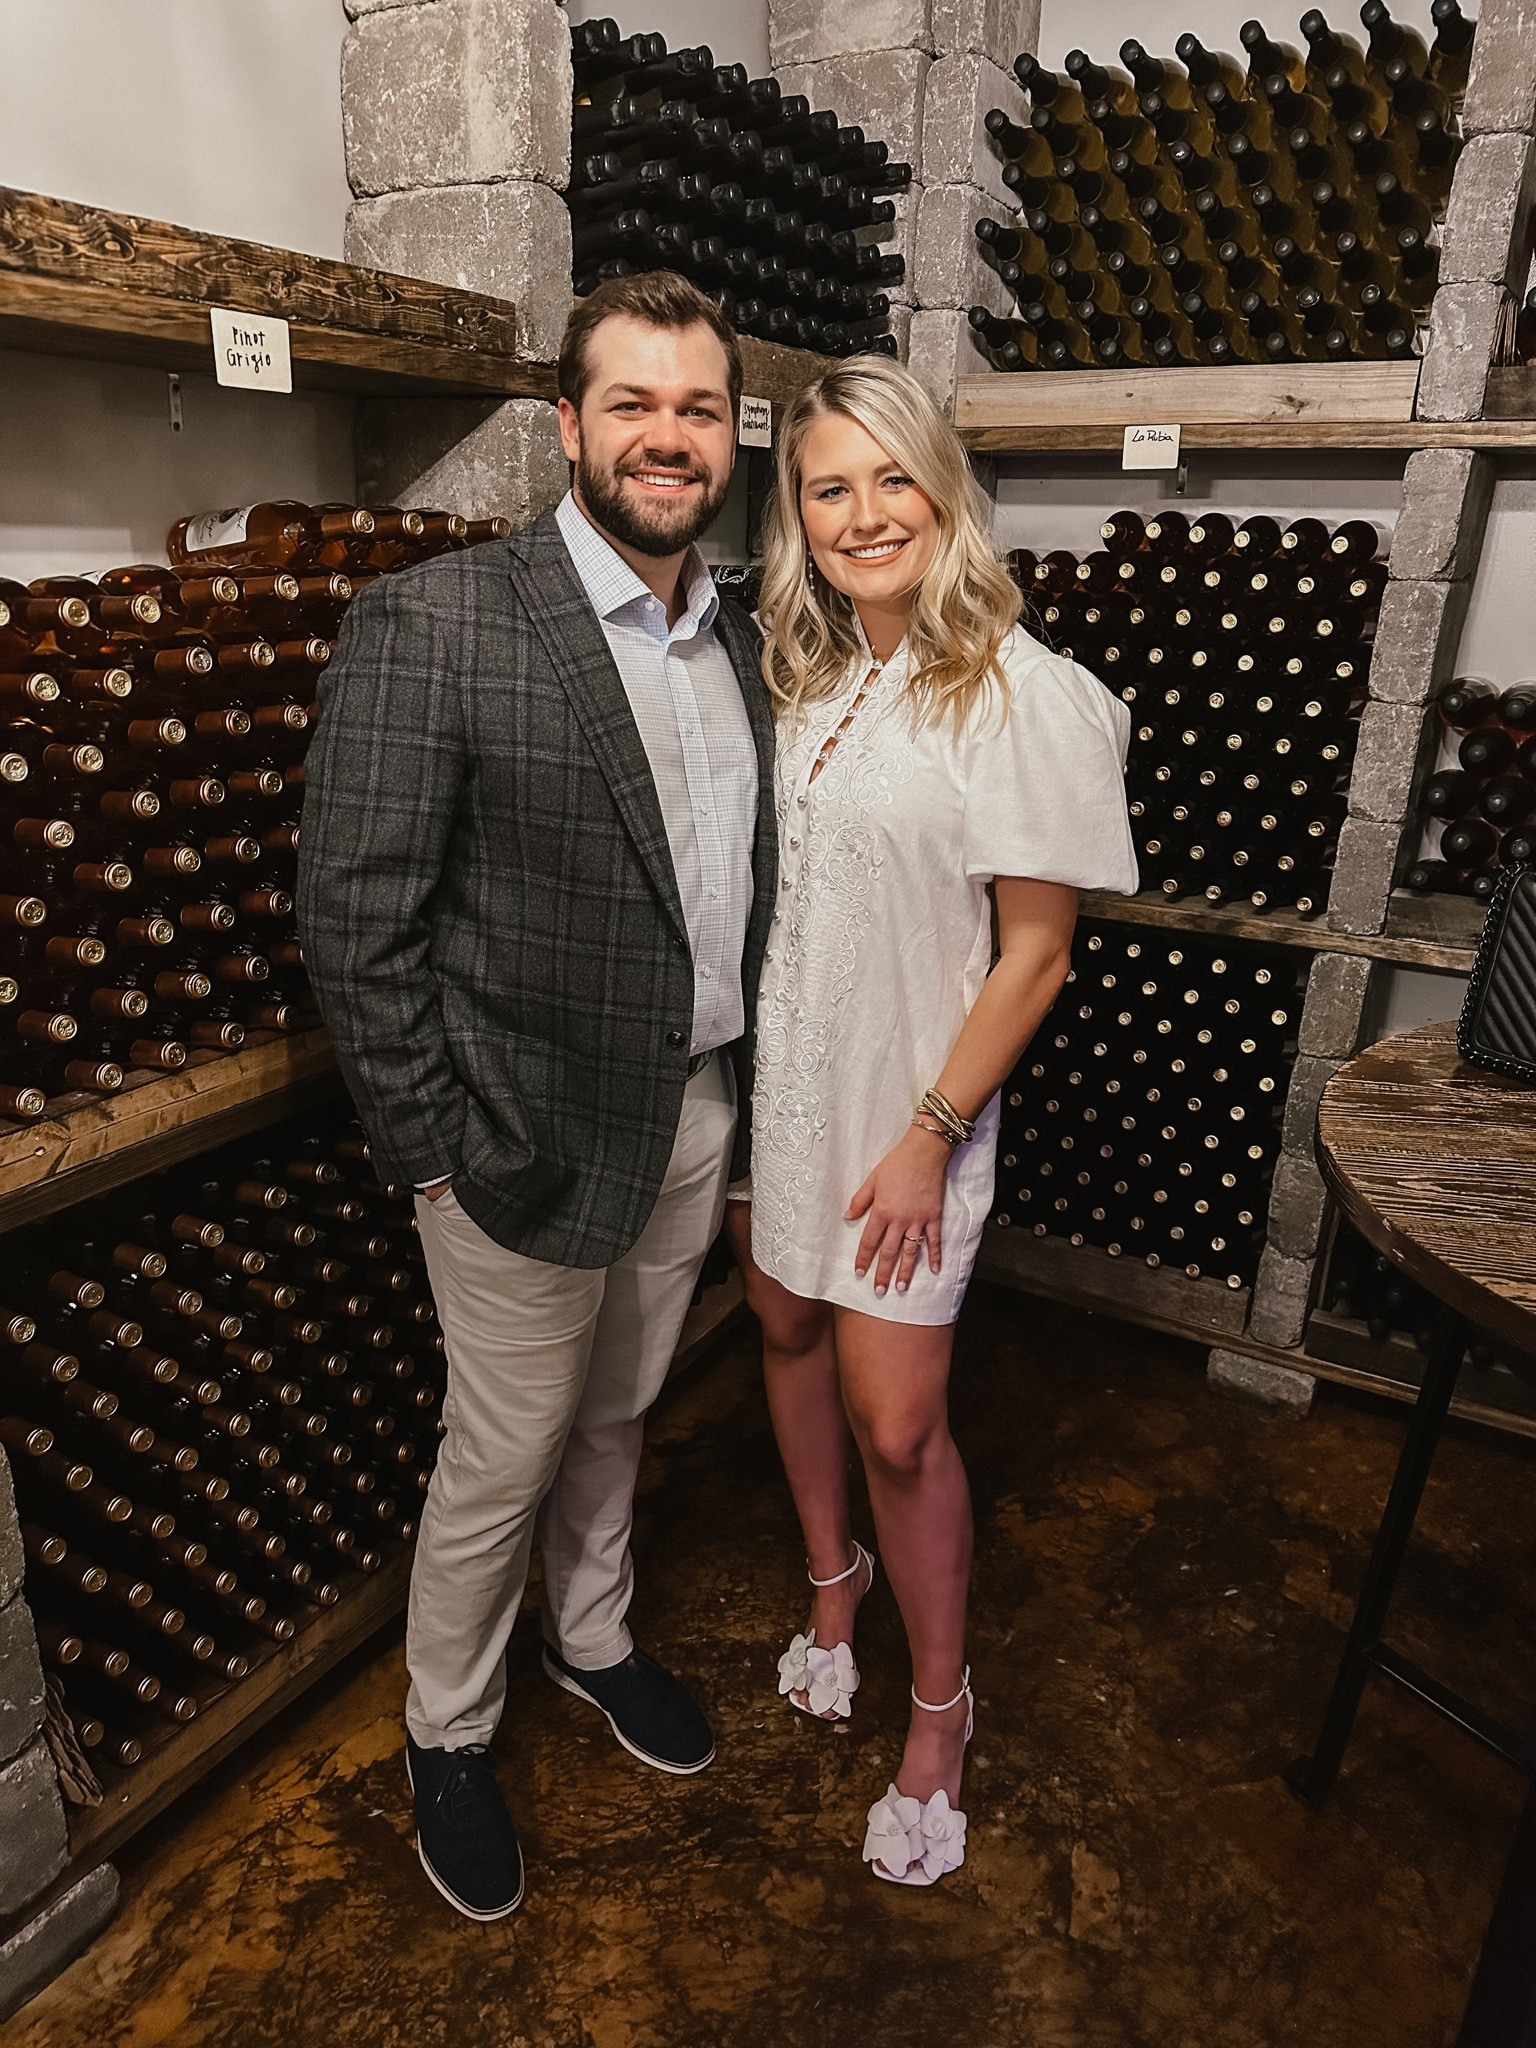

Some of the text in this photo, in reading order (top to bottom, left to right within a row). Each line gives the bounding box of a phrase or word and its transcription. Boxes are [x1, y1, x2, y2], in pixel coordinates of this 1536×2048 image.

[232, 326, 266, 346] Pinot
[226, 348, 271, 374] Grigio
[1131, 429, 1174, 442] La Rubia
